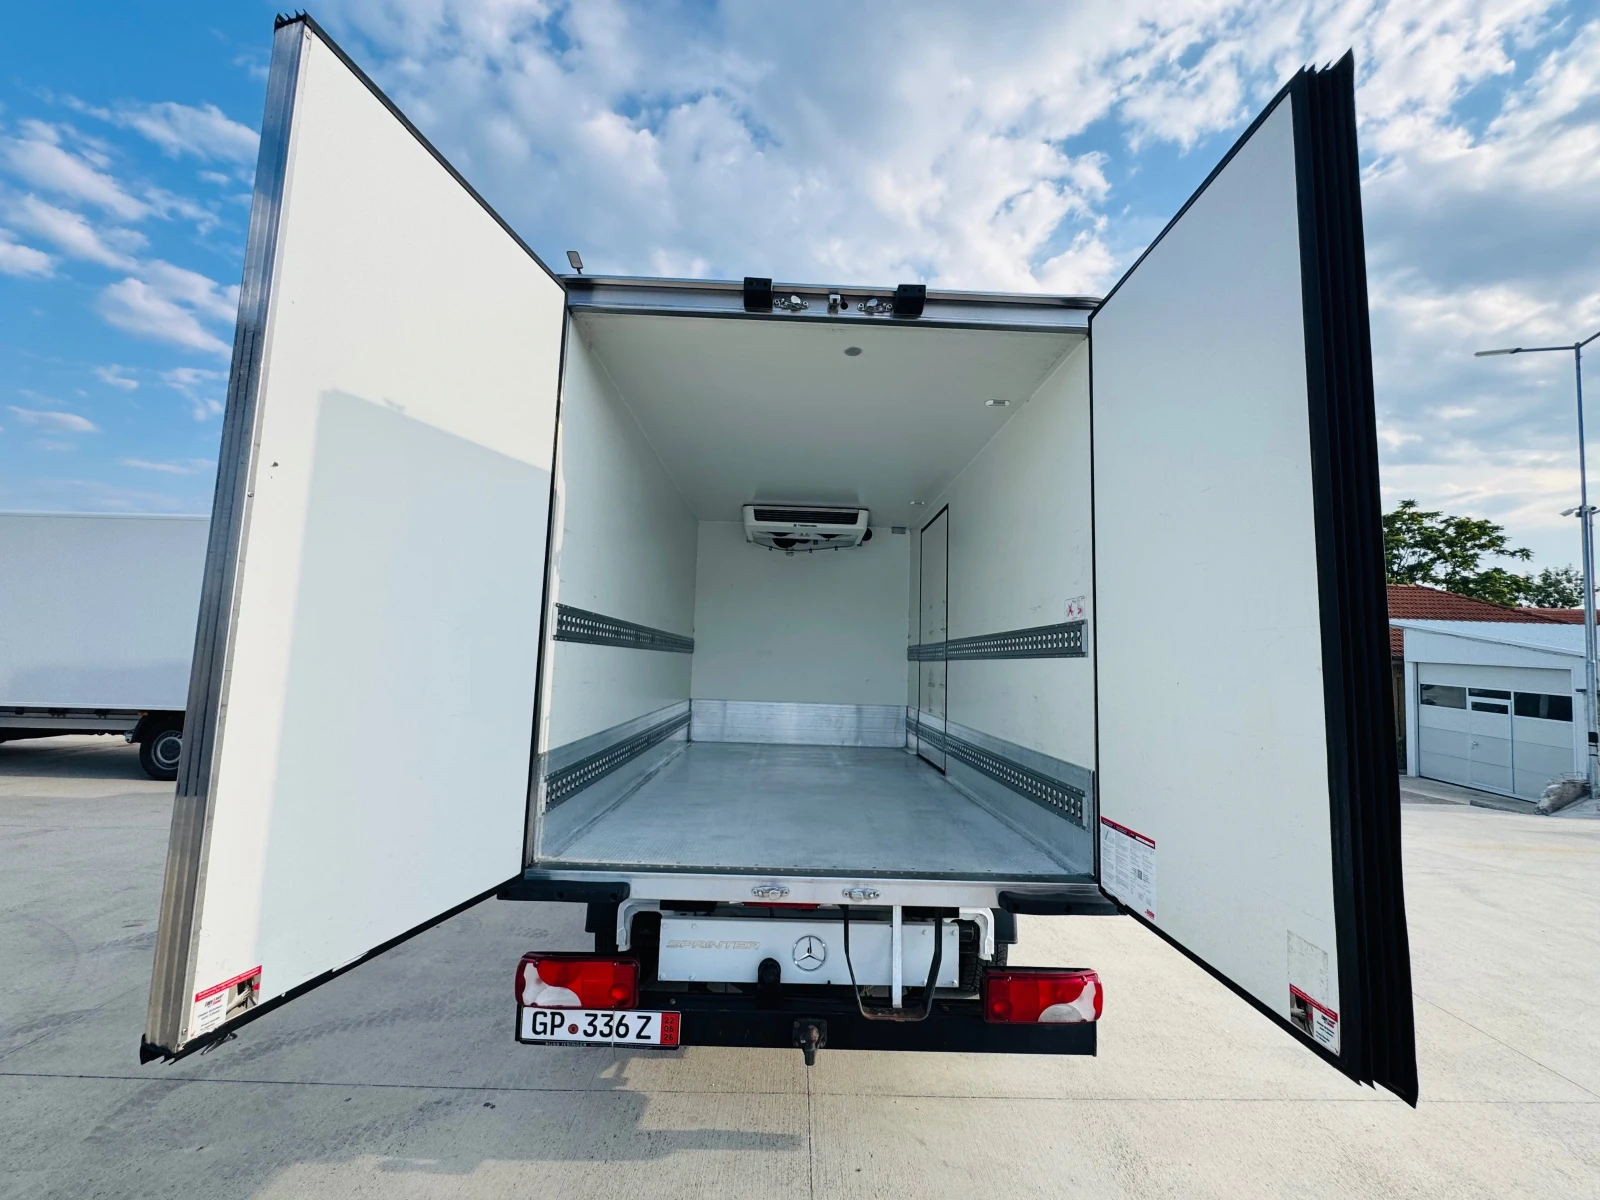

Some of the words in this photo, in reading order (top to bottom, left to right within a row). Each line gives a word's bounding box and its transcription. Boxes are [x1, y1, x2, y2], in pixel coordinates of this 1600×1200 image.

[666, 939, 760, 950] SPRINTER
[664, 1016, 675, 1024] 22
[531, 1010, 565, 1036] GP
[582, 1012, 630, 1039] 336
[636, 1015, 652, 1040] Z
[663, 1025, 674, 1033] 06
[663, 1033, 674, 1041] 26
